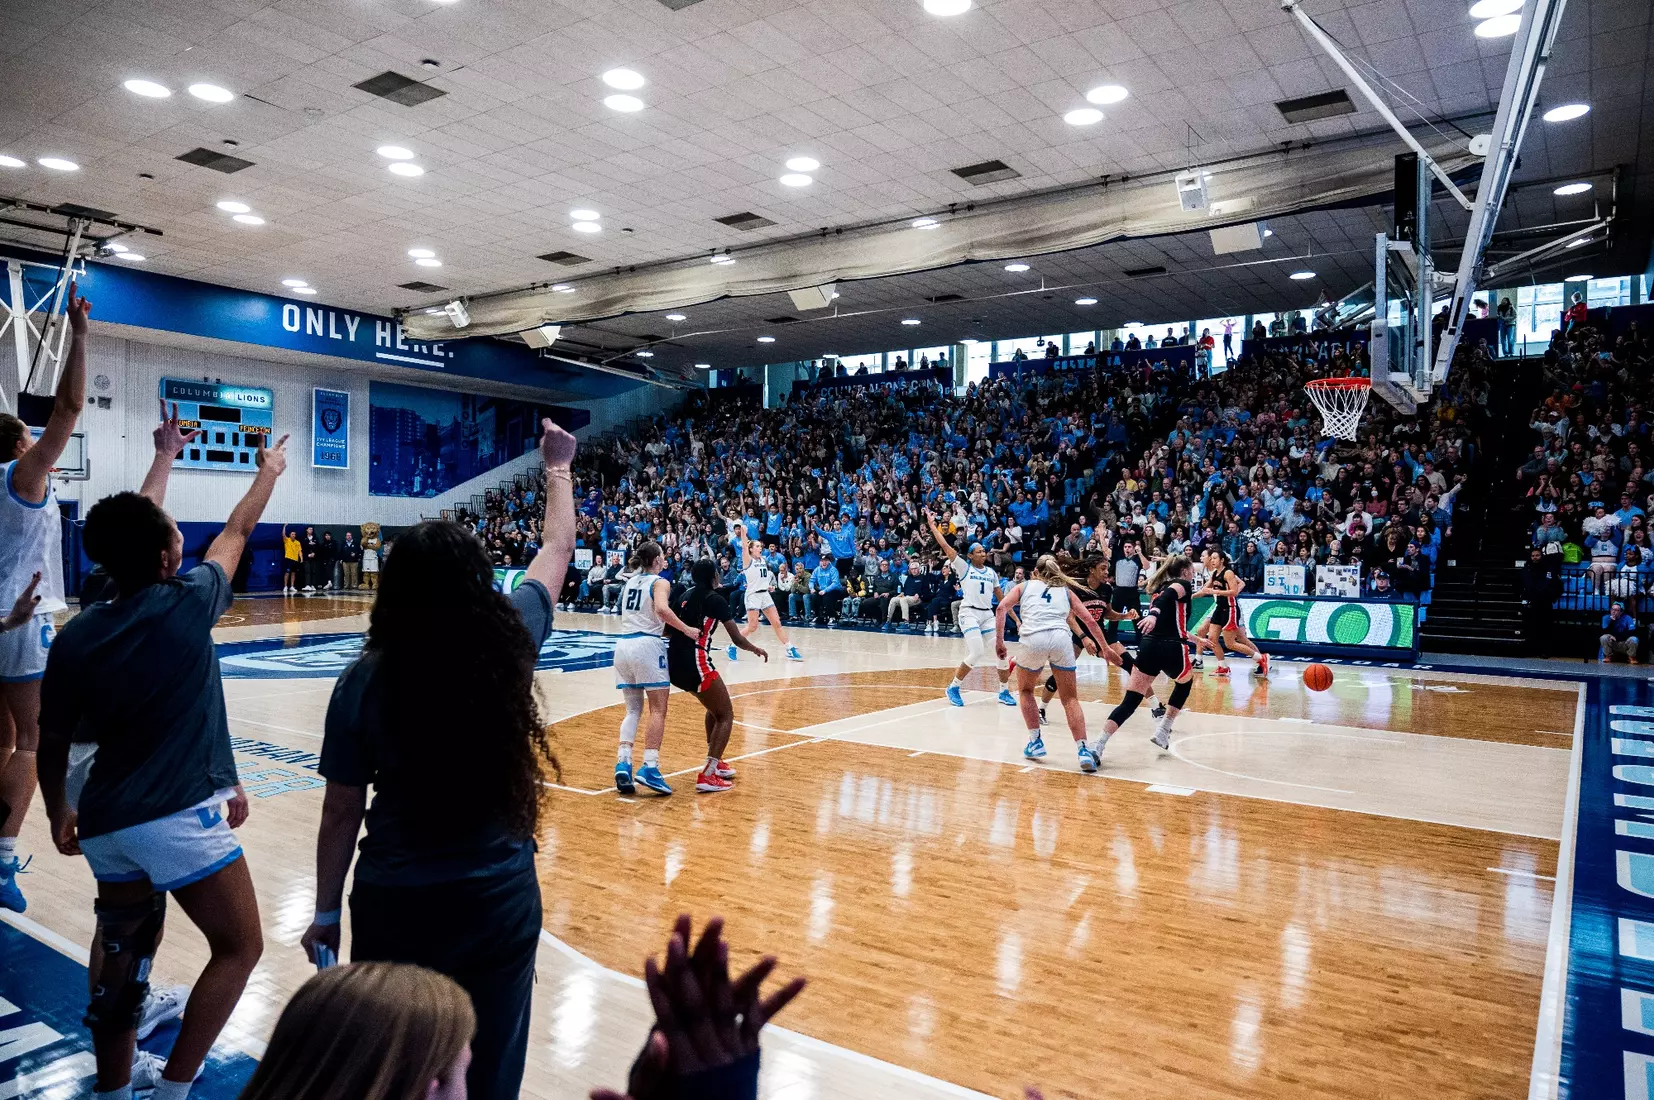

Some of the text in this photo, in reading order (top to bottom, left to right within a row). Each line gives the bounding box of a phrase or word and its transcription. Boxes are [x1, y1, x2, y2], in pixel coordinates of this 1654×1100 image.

[282, 304, 360, 342] ONLY
[173, 386, 266, 403] COLUMBIA LIONS
[760, 568, 768, 578] 10
[980, 582, 985, 594] 1
[1041, 586, 1052, 603] 4
[626, 588, 643, 611] 21
[1240, 598, 1396, 646] GO
